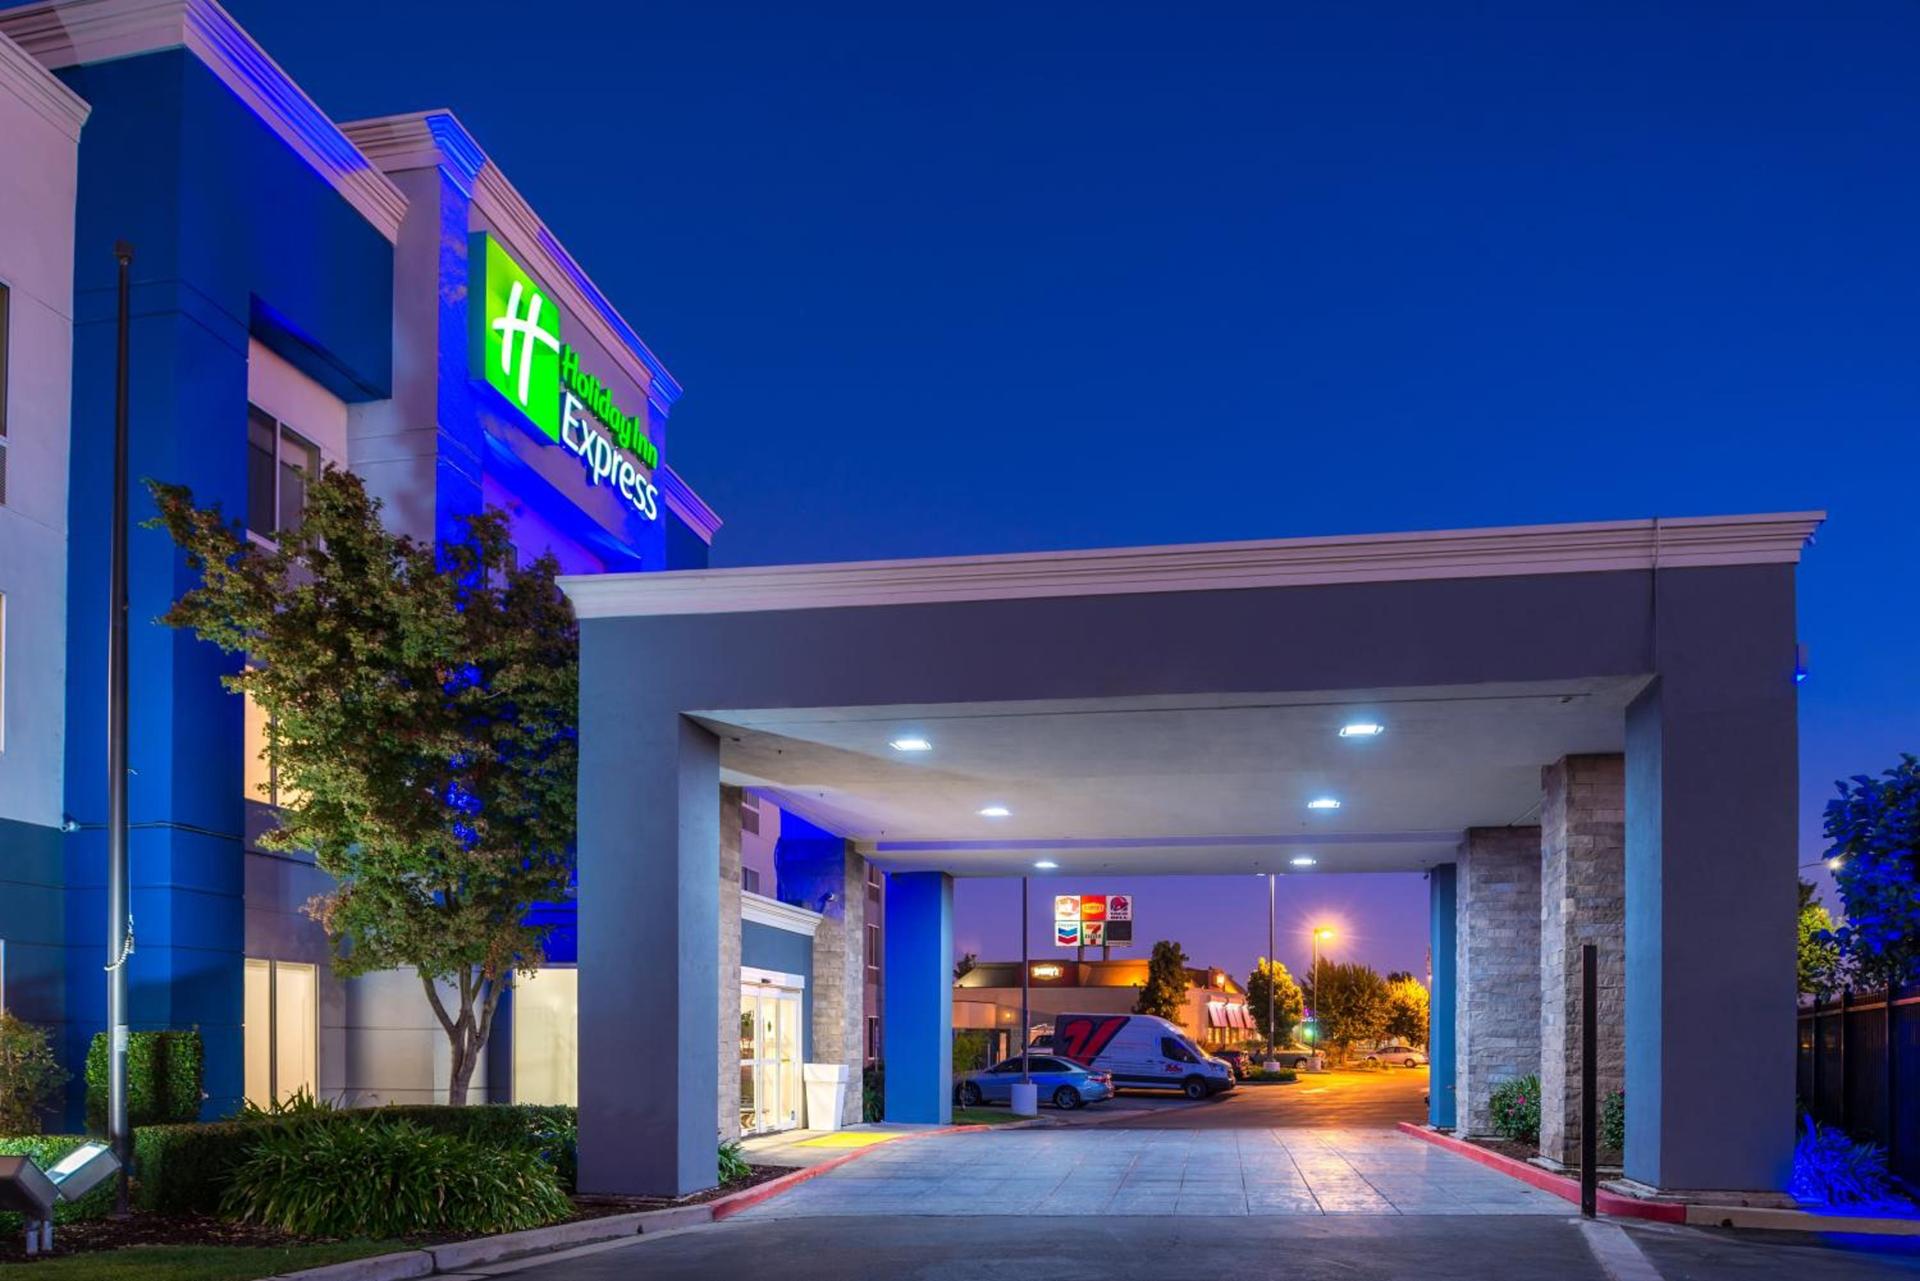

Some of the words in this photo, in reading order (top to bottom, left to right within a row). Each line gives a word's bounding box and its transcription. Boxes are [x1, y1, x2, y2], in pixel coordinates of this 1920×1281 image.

[561, 344, 632, 449] Holiday
[632, 416, 659, 470] Inn
[561, 391, 659, 521] Express
